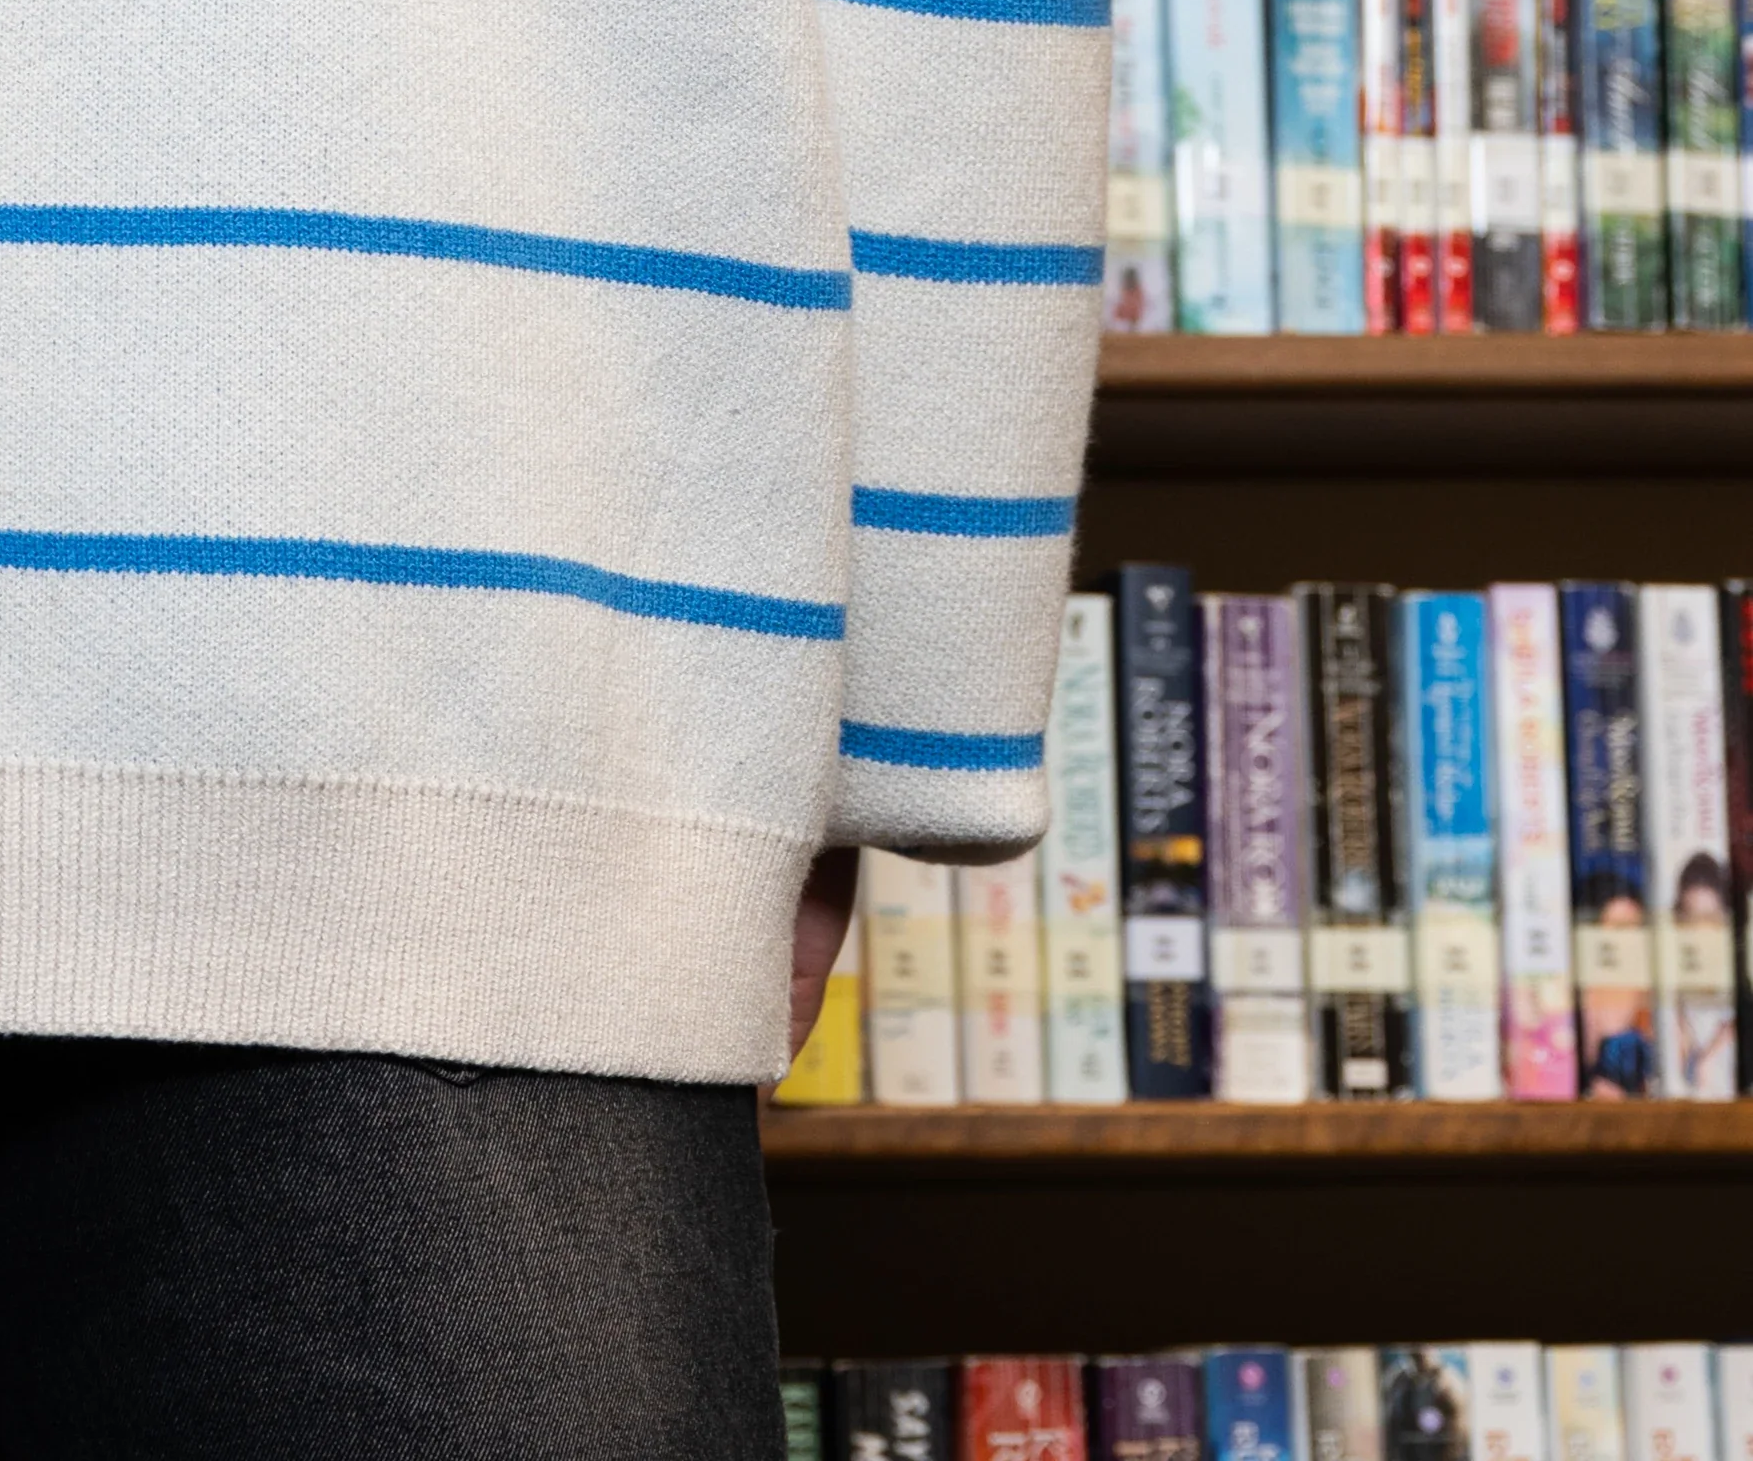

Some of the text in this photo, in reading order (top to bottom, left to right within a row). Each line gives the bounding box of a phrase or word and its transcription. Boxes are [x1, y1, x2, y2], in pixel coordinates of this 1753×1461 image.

[1132, 674, 1170, 836] ROBERTS
[1164, 699, 1196, 810] NORA
[1246, 707, 1286, 824] NORA
